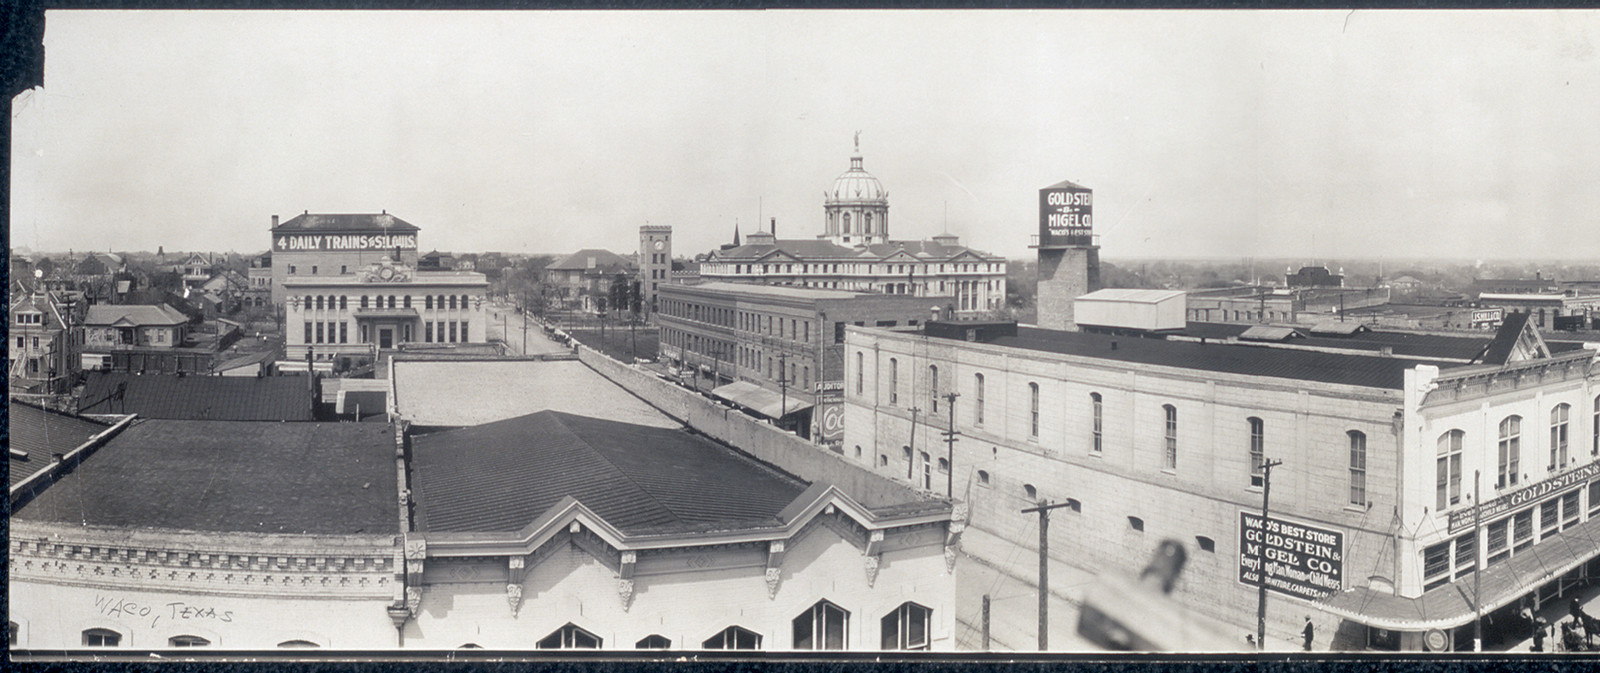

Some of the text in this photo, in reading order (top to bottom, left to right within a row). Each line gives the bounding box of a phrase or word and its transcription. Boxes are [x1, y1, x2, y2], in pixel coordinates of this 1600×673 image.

[1048, 213, 1082, 227] MIGEL
[277, 235, 287, 250] 4
[289, 235, 322, 250] DAILY
[324, 234, 368, 250] TRAINS
[1510, 466, 1593, 506] GOLDSTEIN
[1281, 524, 1306, 538] BEST
[1305, 530, 1337, 546] STORE
[1331, 551, 1341, 562] &
[1306, 557, 1338, 575] CO.
